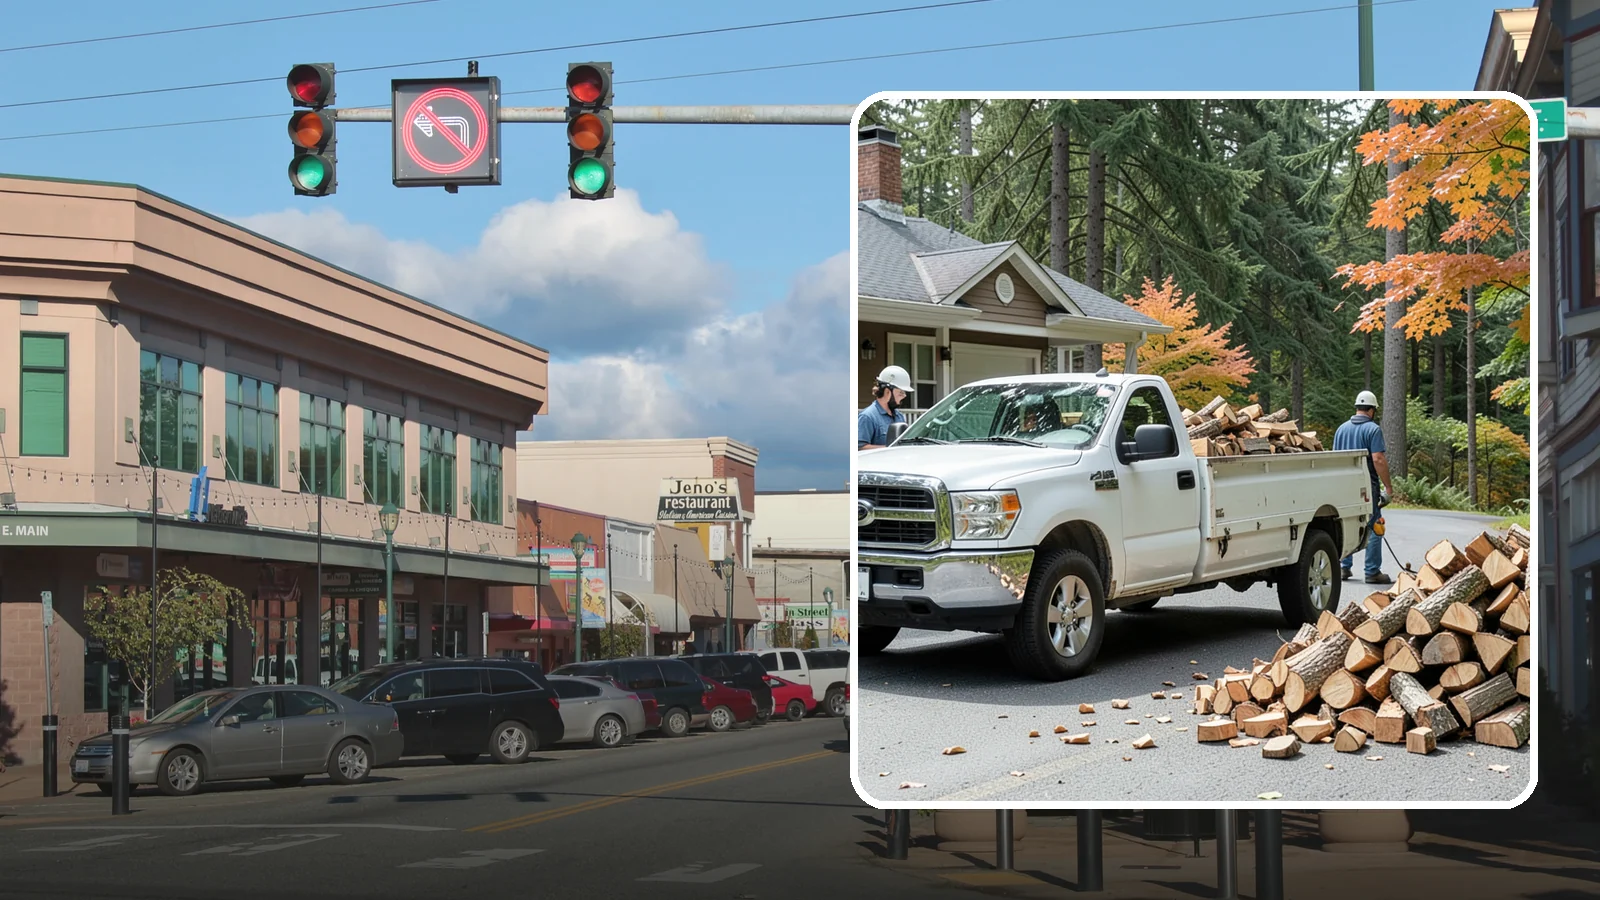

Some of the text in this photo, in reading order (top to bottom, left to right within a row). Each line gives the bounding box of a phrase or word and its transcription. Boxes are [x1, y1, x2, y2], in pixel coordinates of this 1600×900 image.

[670, 480, 727, 494] Jeno's
[665, 497, 731, 509] restaurant
[658, 510, 681, 519] Italian
[686, 510, 714, 519] American
[715, 509, 737, 519] Cuisine
[2, 525, 49, 536] E. MAIN
[797, 607, 828, 616] Street
